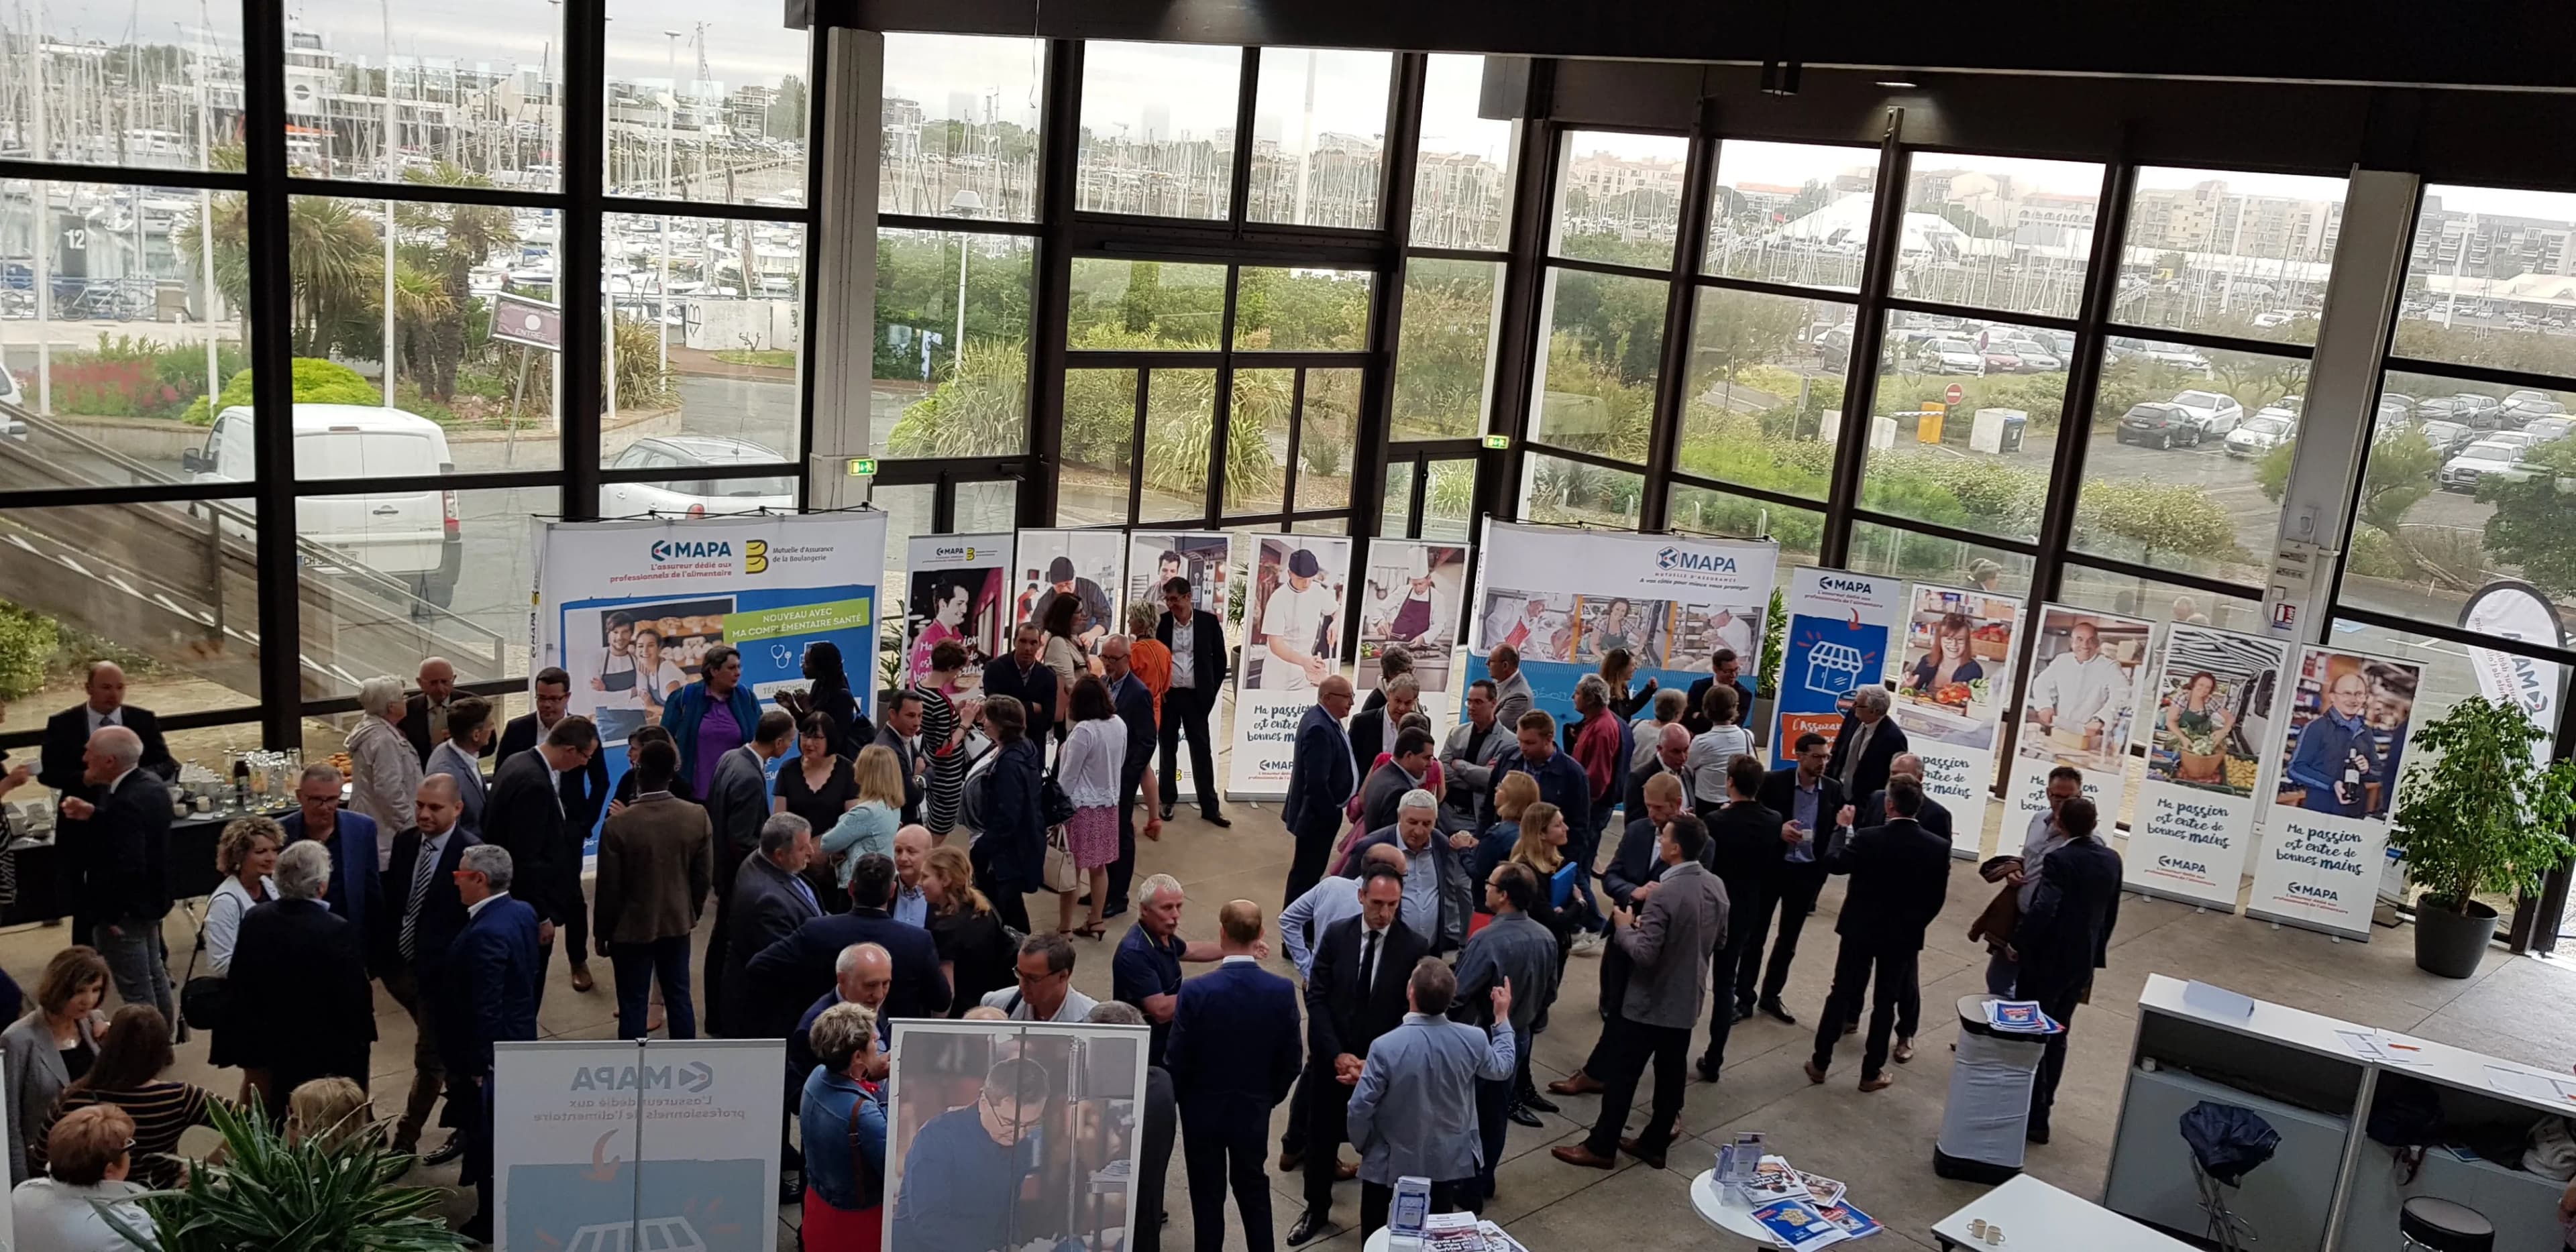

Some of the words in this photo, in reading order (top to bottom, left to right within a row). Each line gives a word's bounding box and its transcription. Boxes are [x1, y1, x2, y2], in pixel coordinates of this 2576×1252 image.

[64, 229, 86, 249] 12
[675, 541, 732, 558] MAPA
[651, 563, 692, 571] L'assureur
[790, 555, 826, 563] Boulangerie
[1680, 552, 1737, 573] MAPA
[610, 571, 669, 583] professionnels
[1834, 579, 1872, 594] MAPA
[763, 610, 806, 623] NOUVEAU
[808, 608, 833, 618] AVEC
[732, 628, 747, 638] MA
[748, 618, 831, 636] COMPLÉMENTAIRE
[833, 612, 861, 625] SANTÉ
[763, 681, 811, 695] TÉLÉCONSUL
[1254, 704, 1269, 714] Ma
[1271, 703, 1309, 720] passio
[1254, 718, 1269, 730] est
[1271, 718, 1299, 730] entre
[1247, 730, 1283, 742] bonnes
[1272, 760, 1294, 770] MAP
[1923, 770, 1953, 782] ntre
[1954, 773, 1966, 783] de
[2030, 775, 2046, 786] Ma
[1933, 783, 1973, 799] mains
[2029, 789, 2045, 801] est
[2021, 799, 2052, 811] bonn
[2157, 798, 2174, 809] Ma
[2176, 802, 2229, 819] passion
[2155, 812, 2174, 824] est
[2175, 817, 2209, 831] entre
[2211, 821, 2224, 832] de
[2147, 822, 2188, 840] bonnes
[2188, 832, 2231, 850] mains
[2287, 823, 2304, 835] Ma
[2307, 828, 2363, 844] passion
[2285, 838, 2304, 850] est
[2305, 842, 2343, 857] entre
[2343, 847, 2357, 858] de
[2172, 858, 2206, 874] MAPA
[2276, 848, 2318, 866] bonnes
[2320, 859, 2365, 876] mains
[2302, 885, 2339, 901] MAPA
